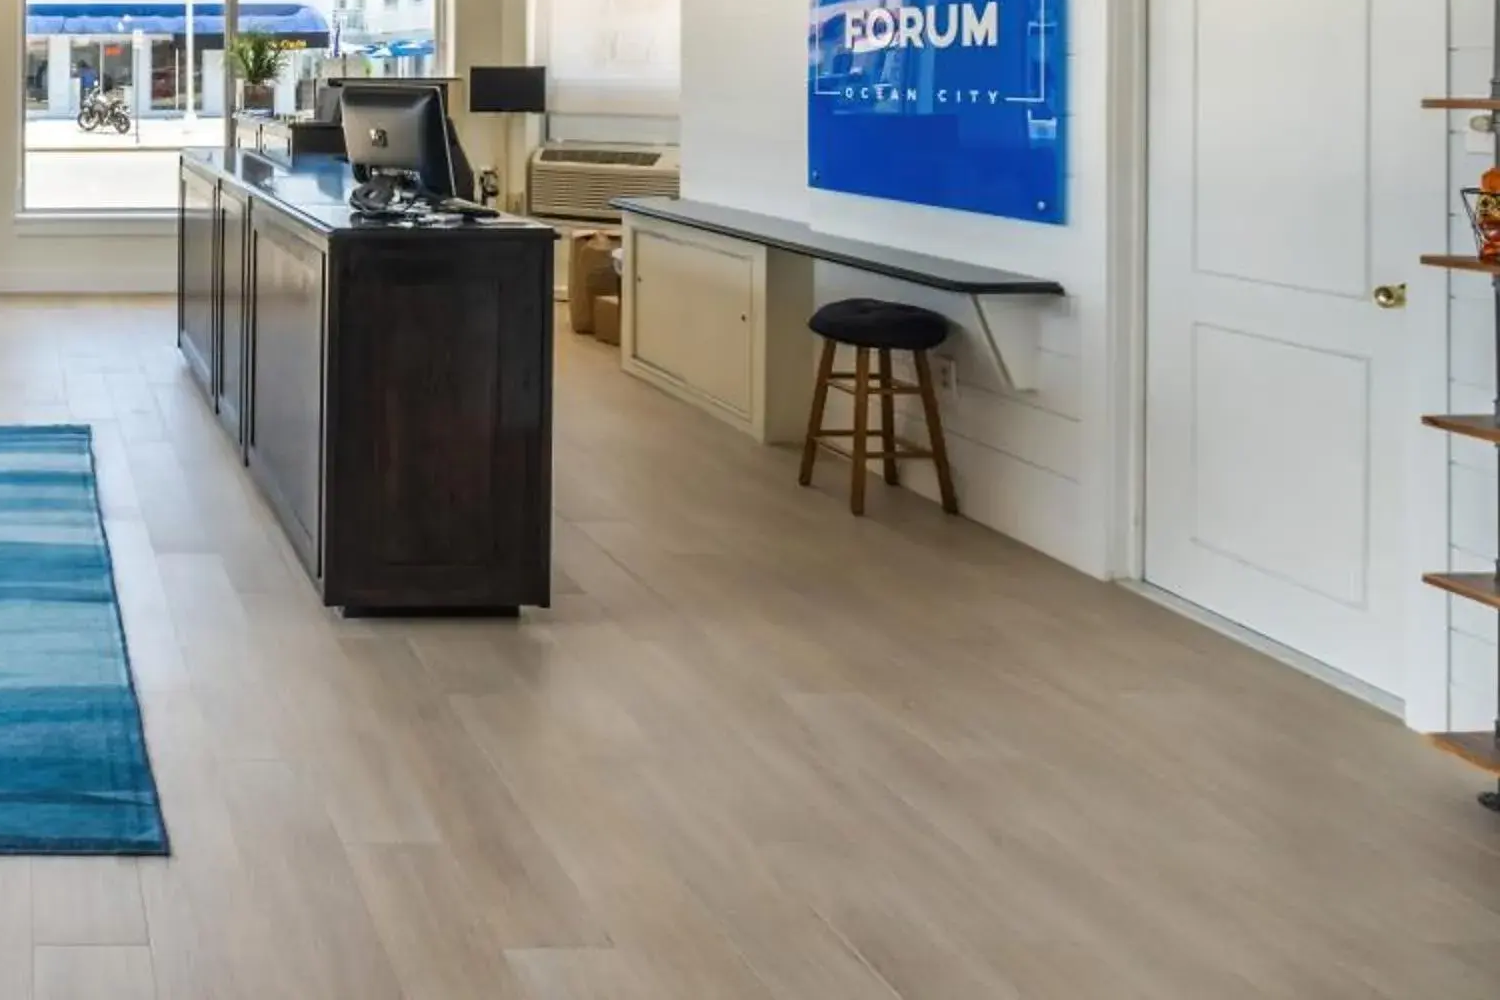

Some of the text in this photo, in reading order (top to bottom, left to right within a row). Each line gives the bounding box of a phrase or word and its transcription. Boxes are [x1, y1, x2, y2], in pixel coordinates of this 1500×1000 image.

[844, 1, 998, 49] FORUM
[845, 87, 999, 104] OCEAN CITY
